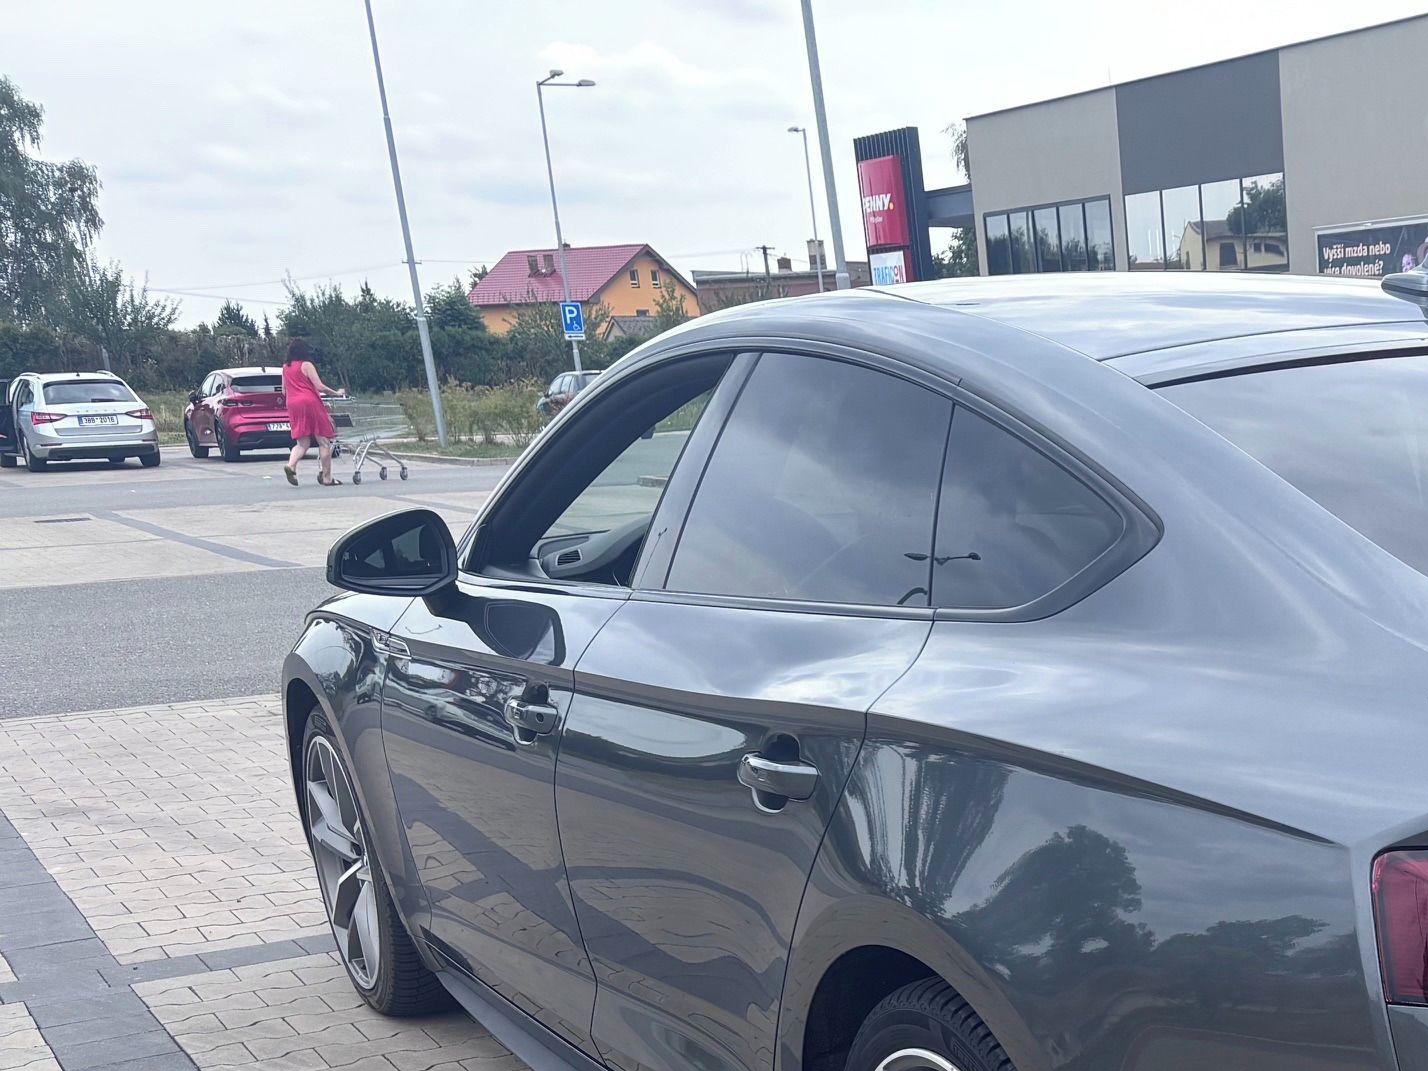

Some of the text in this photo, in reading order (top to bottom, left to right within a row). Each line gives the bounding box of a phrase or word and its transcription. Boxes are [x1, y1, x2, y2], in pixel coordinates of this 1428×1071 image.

[1323, 240, 1391, 262] Vyšší mzda nebo
[1341, 259, 1384, 276] dovolené?
[565, 306, 577, 324] P
